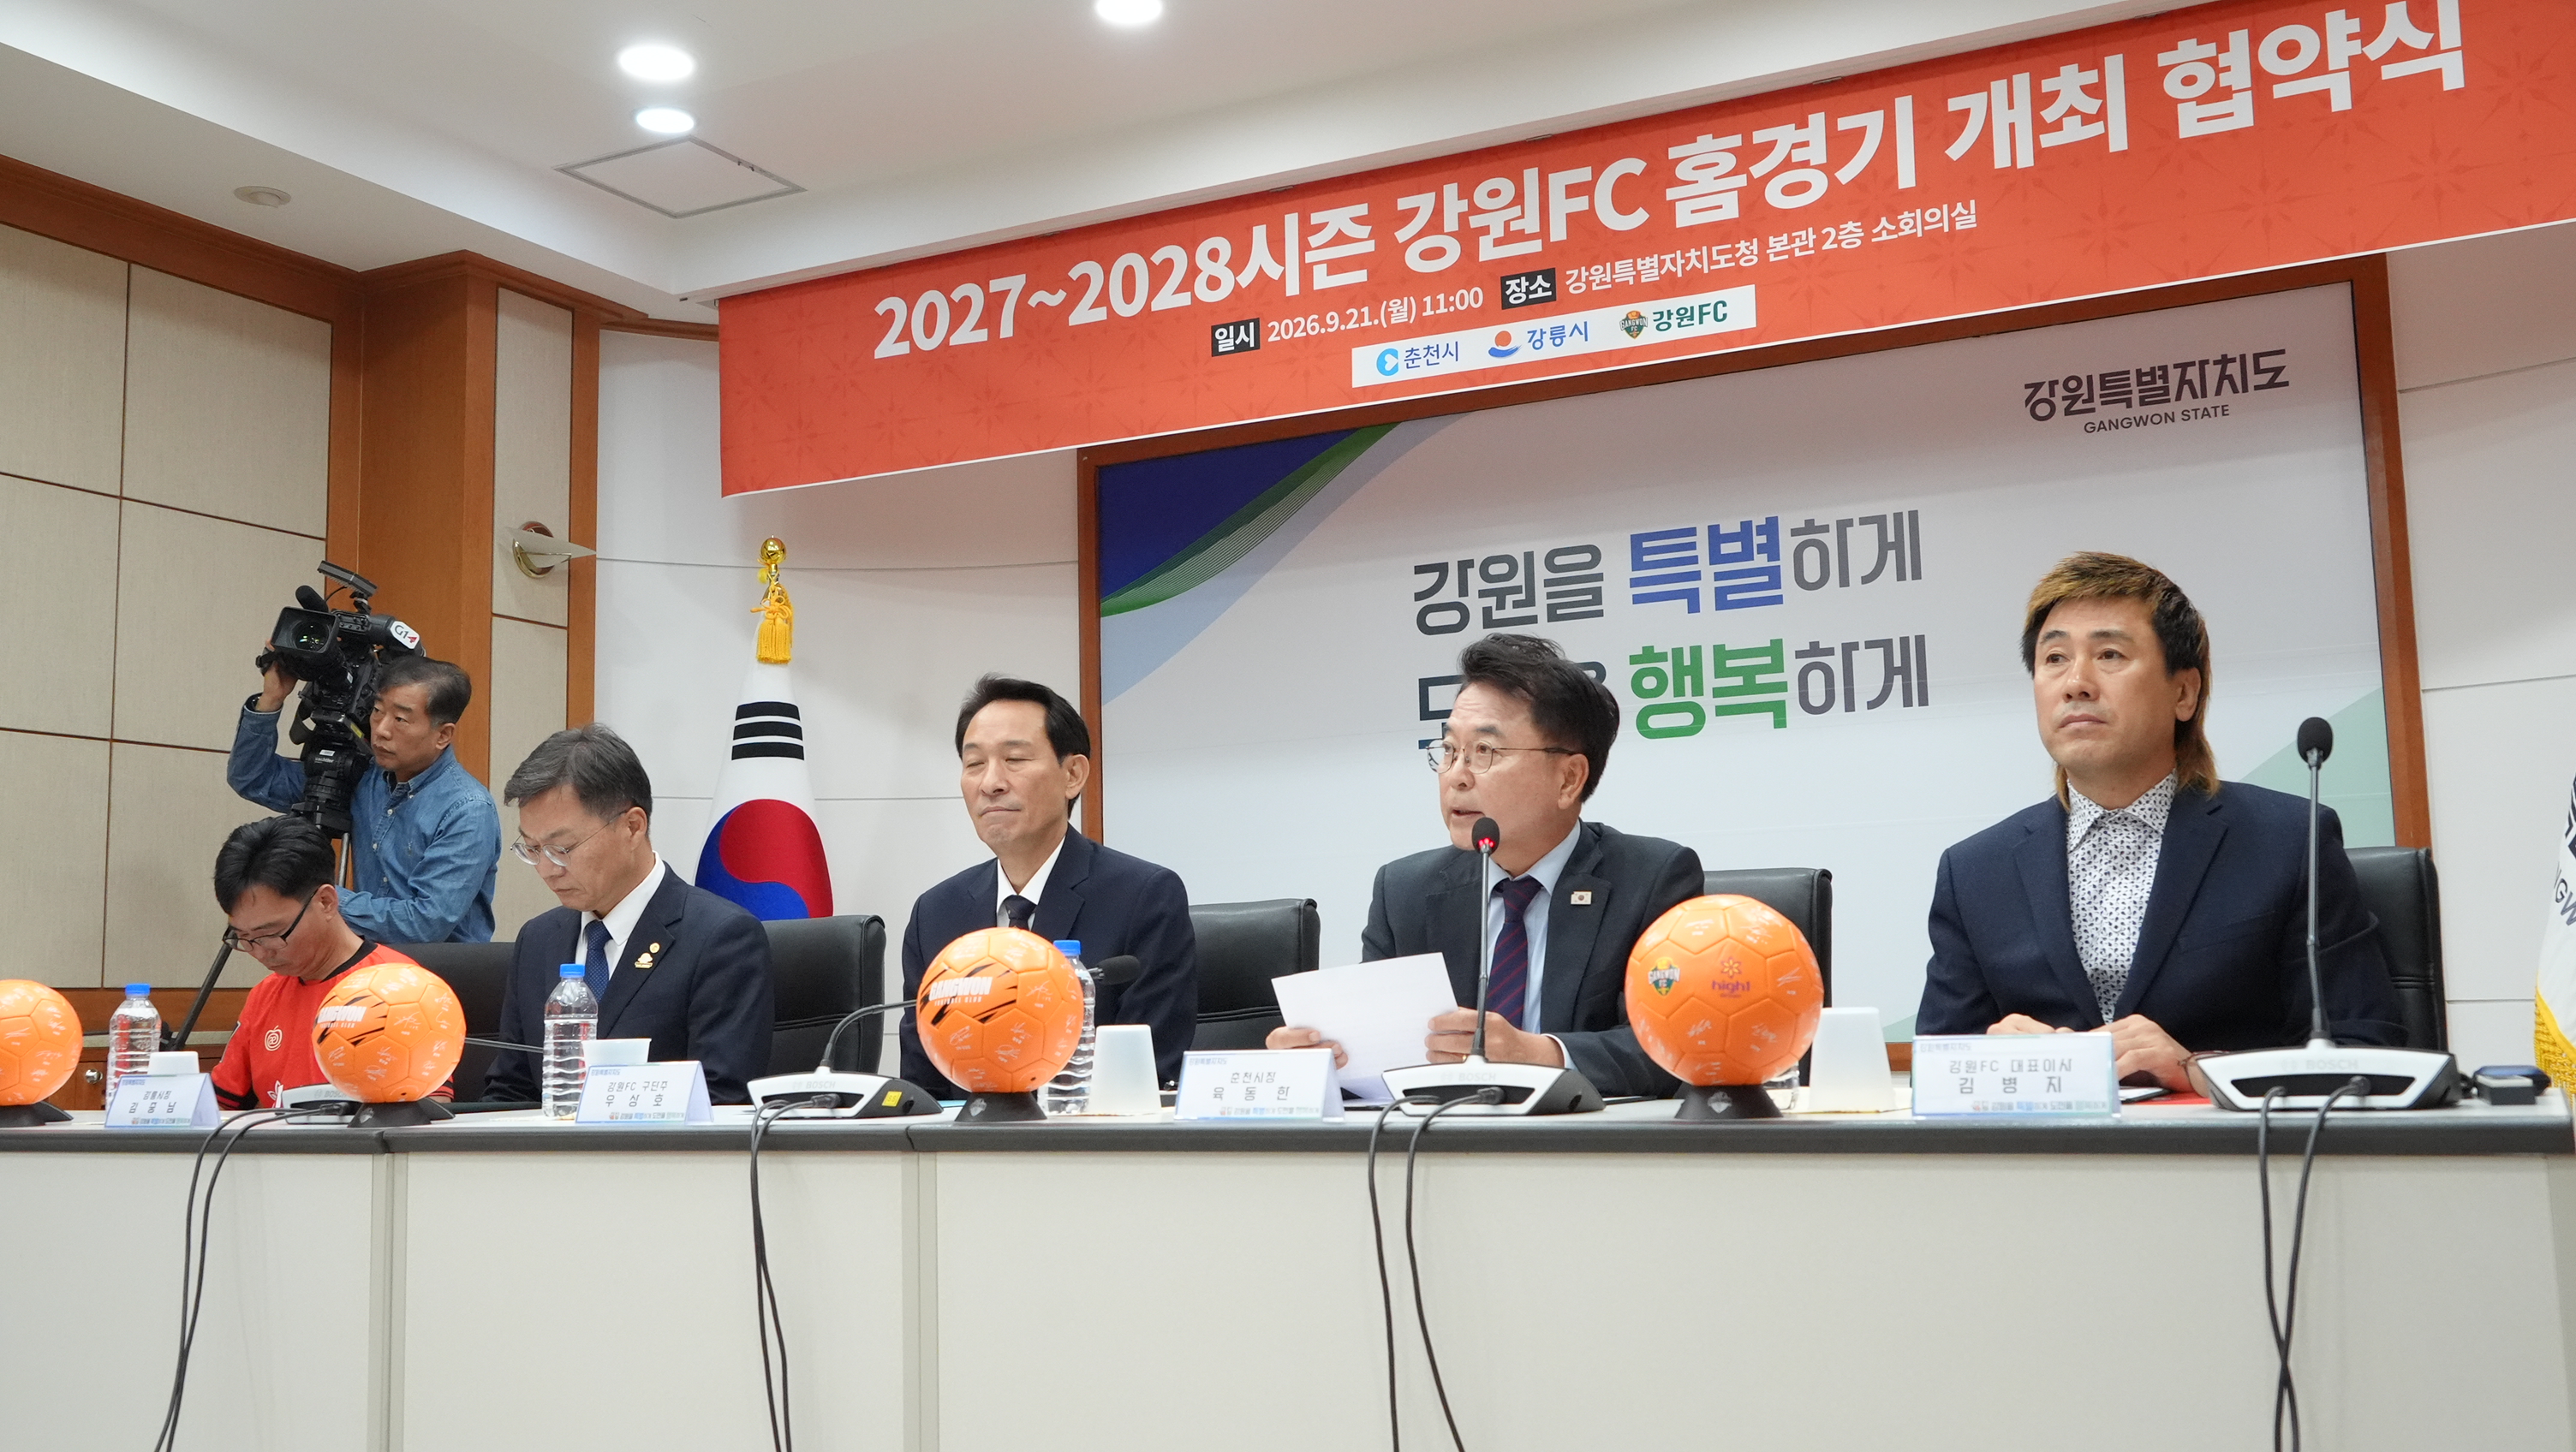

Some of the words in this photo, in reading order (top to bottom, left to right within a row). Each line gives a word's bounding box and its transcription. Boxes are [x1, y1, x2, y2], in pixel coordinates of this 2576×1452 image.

[874, 203, 1374, 359] 2027~2028시즌
[1394, 158, 1649, 272] 강원FC
[1667, 95, 1916, 228] 홈경기
[1945, 54, 2127, 169] 개최
[2158, 0, 2464, 138] 협약식
[1215, 322, 1255, 352] 일시
[1268, 296, 1416, 342] 2026.9.21.(월)
[1422, 287, 1483, 316] 11:00
[1506, 275, 1552, 304] 장소
[1566, 238, 1758, 294] 강원특별자치도청
[1767, 228, 1816, 261] 본관
[1822, 221, 1863, 250] 2층
[1872, 199, 1977, 241] 소회의실
[1619, 317, 1648, 331] GANGWON
[1653, 301, 1727, 332] 강원FC
[1528, 322, 1589, 351] 강릉시
[1404, 342, 1458, 369] 춘천시
[2024, 348, 2289, 423] 강원특별자치도
[2084, 411, 2176, 434] GANGWON
[2181, 404, 2230, 422] STATE
[1414, 544, 1604, 635] 강원을
[1630, 510, 1922, 615] 특별하게
[1630, 634, 1929, 740] 행복하게
[928, 977, 993, 1002] GANGWON
[1231, 1072, 1276, 1084] 춘천시장
[2010, 1058, 2072, 1074] 대표이사
[607, 1081, 637, 1092] 강원FC
[642, 1080, 668, 1092] 구단주
